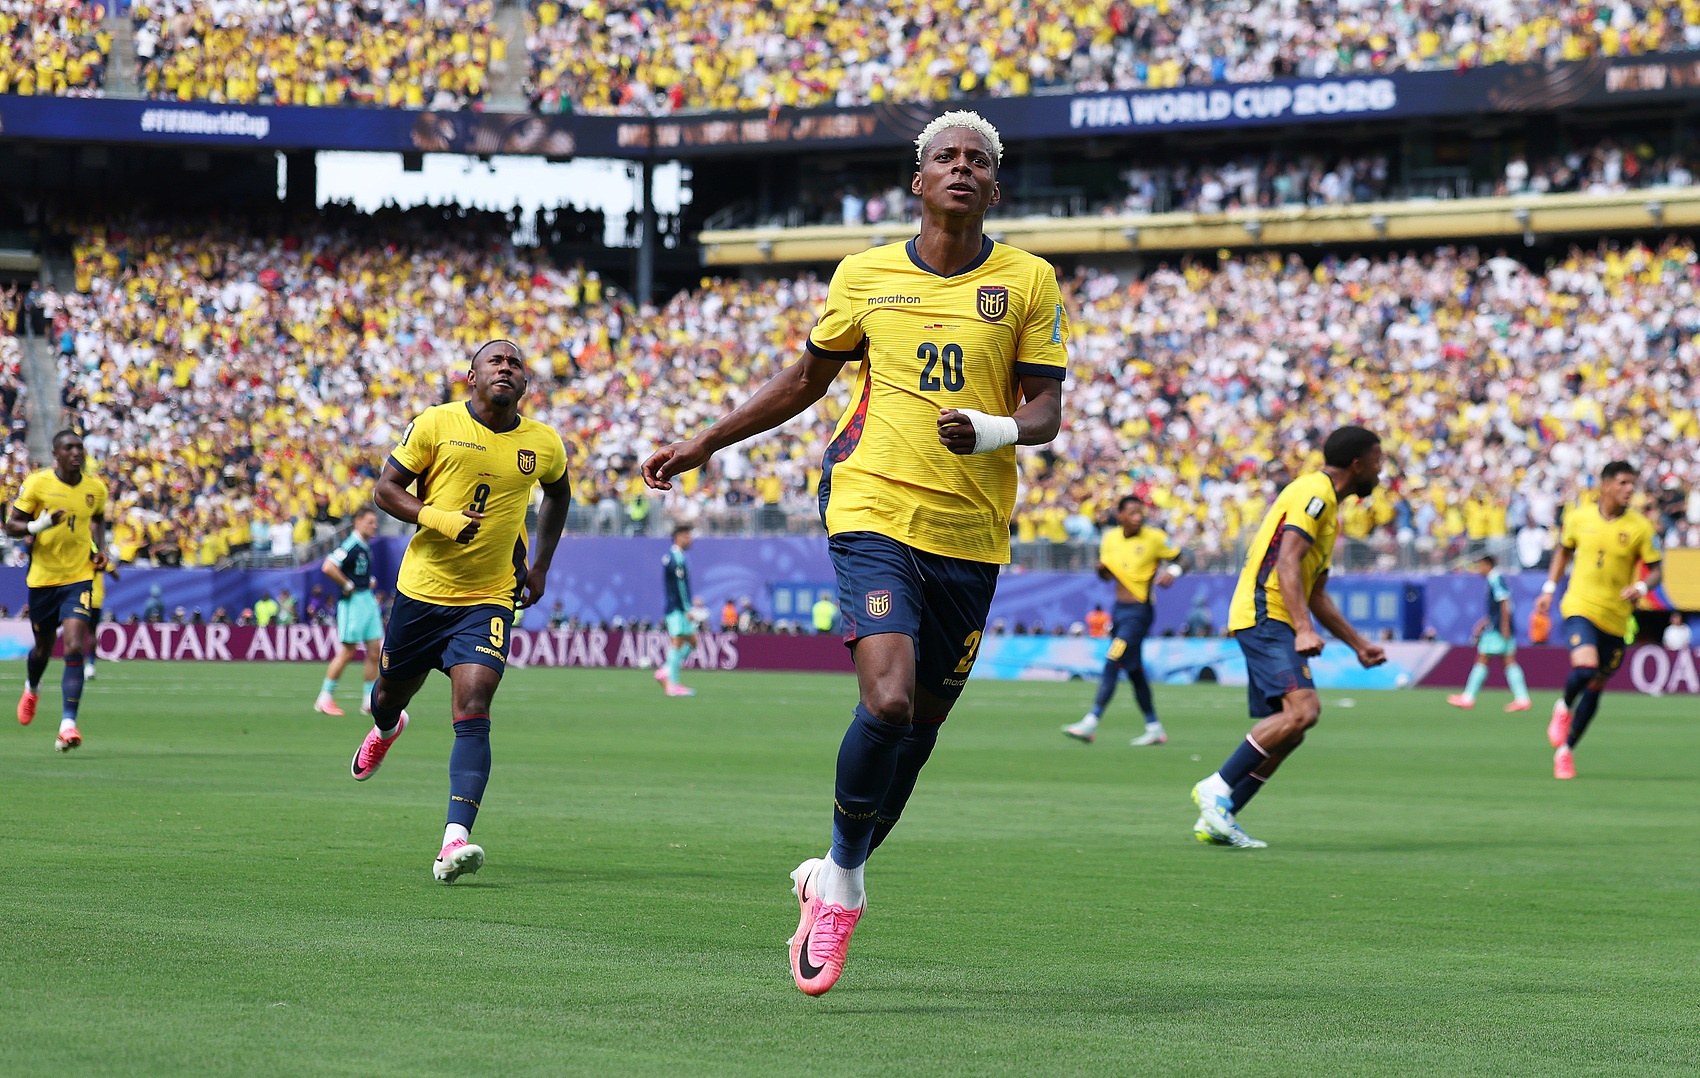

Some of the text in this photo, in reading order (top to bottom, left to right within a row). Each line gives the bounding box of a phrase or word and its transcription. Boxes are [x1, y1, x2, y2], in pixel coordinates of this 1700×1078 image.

[1070, 78, 1396, 128] FIFA WORLD CUP 2026
[867, 294, 921, 306] marathon
[917, 342, 965, 392] 20
[449, 439, 487, 452] marathon
[469, 483, 491, 514] 9
[95, 623, 343, 662] QATAR AIRW
[489, 616, 504, 648] 9
[506, 627, 739, 670] QATAR AIRAYS
[954, 630, 981, 672] 2
[1630, 643, 1700, 697] QA
